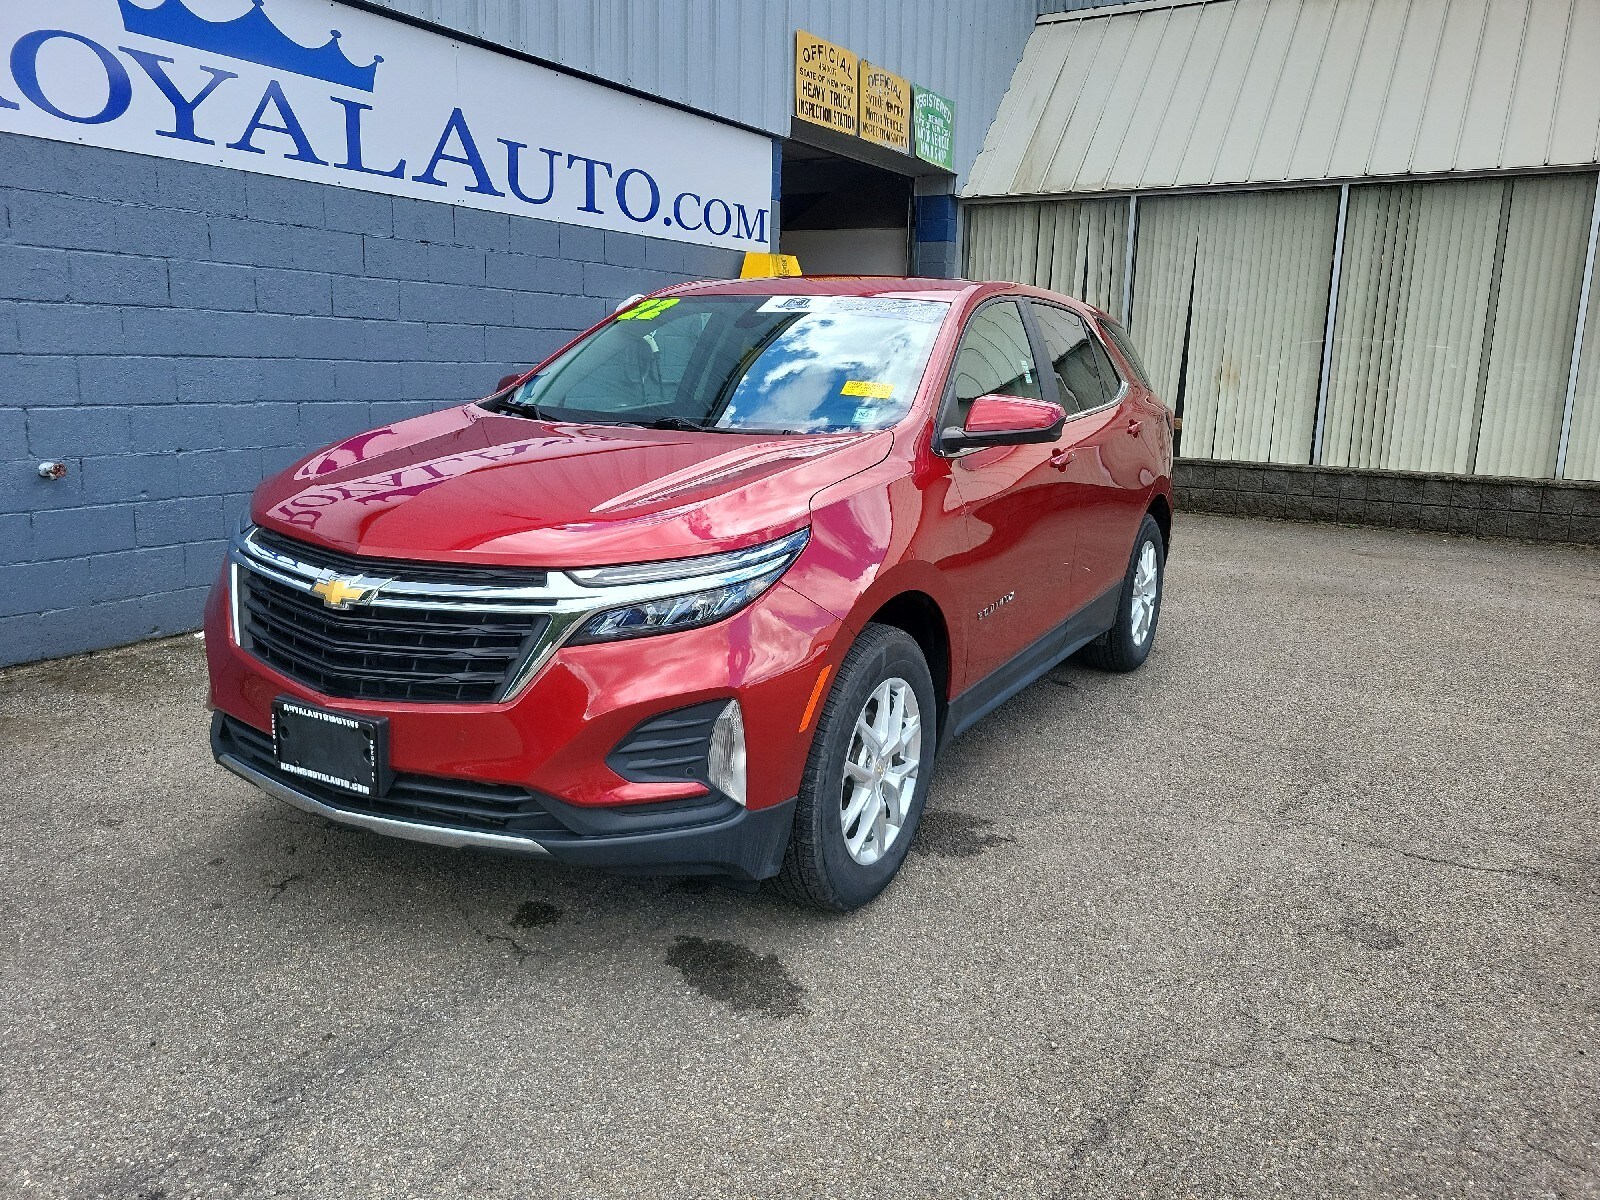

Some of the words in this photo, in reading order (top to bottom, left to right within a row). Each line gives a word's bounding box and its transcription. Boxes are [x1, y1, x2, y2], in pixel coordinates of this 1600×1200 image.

[799, 67, 817, 81] STATE
[817, 71, 826, 83] OF
[802, 44, 853, 81] OFFICIAL
[802, 80, 826, 103] HEAVY
[829, 90, 852, 111] TRUCK
[867, 73, 903, 104] OFFICIAL
[798, 98, 832, 122] INSPECTION
[833, 109, 856, 131] STATION
[883, 112, 904, 134] VEHICLE
[0, 29, 769, 243] OYALAUTO.COM
